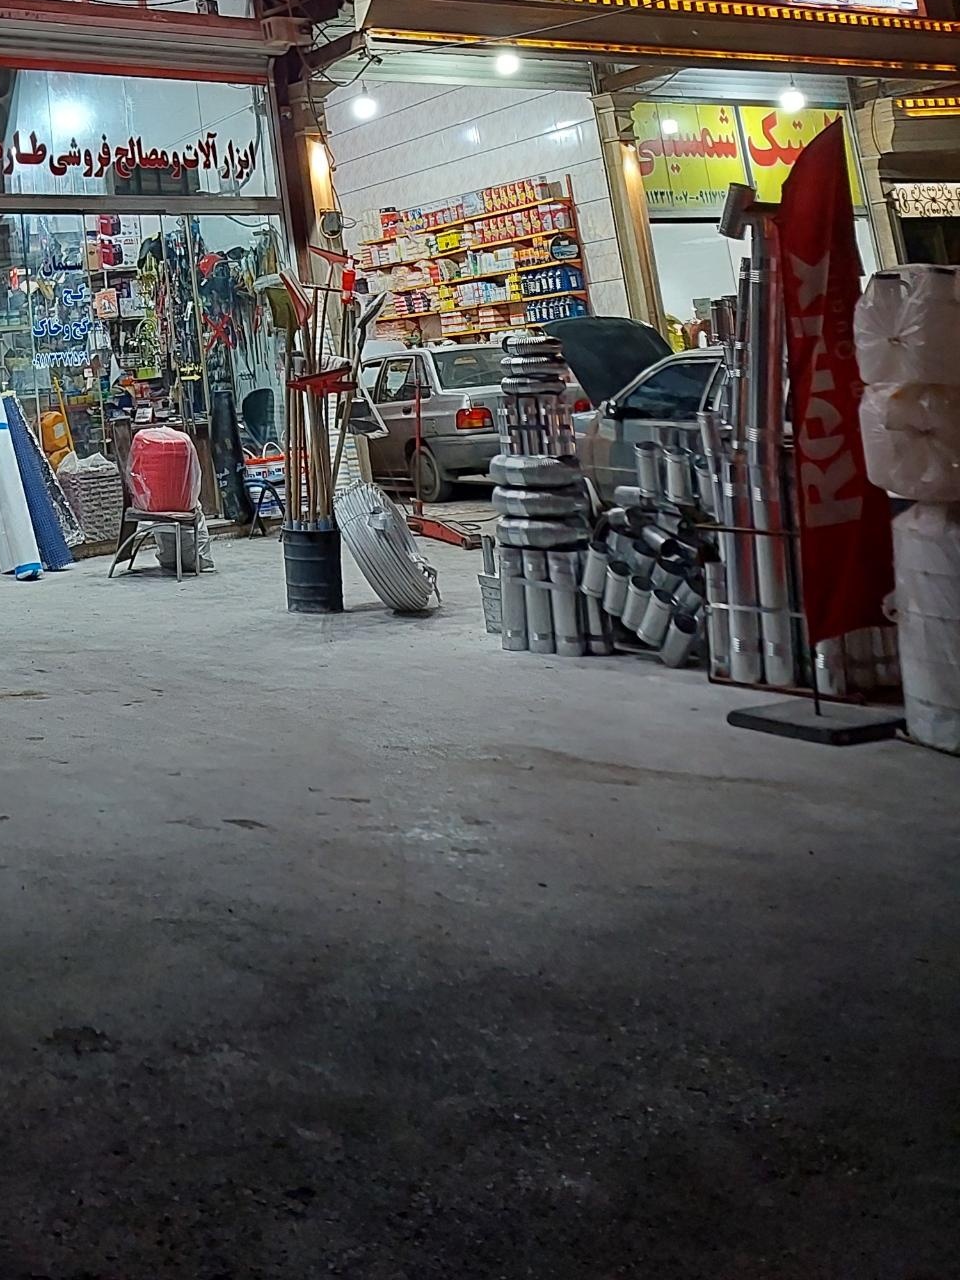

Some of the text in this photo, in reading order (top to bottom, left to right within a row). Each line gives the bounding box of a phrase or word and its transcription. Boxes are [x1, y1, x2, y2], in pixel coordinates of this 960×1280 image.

[49, 134, 111, 178] فروشی
[115, 135, 169, 178] مصالح
[42, 254, 83, 277] سیمان
[32, 317, 62, 337] خاک
